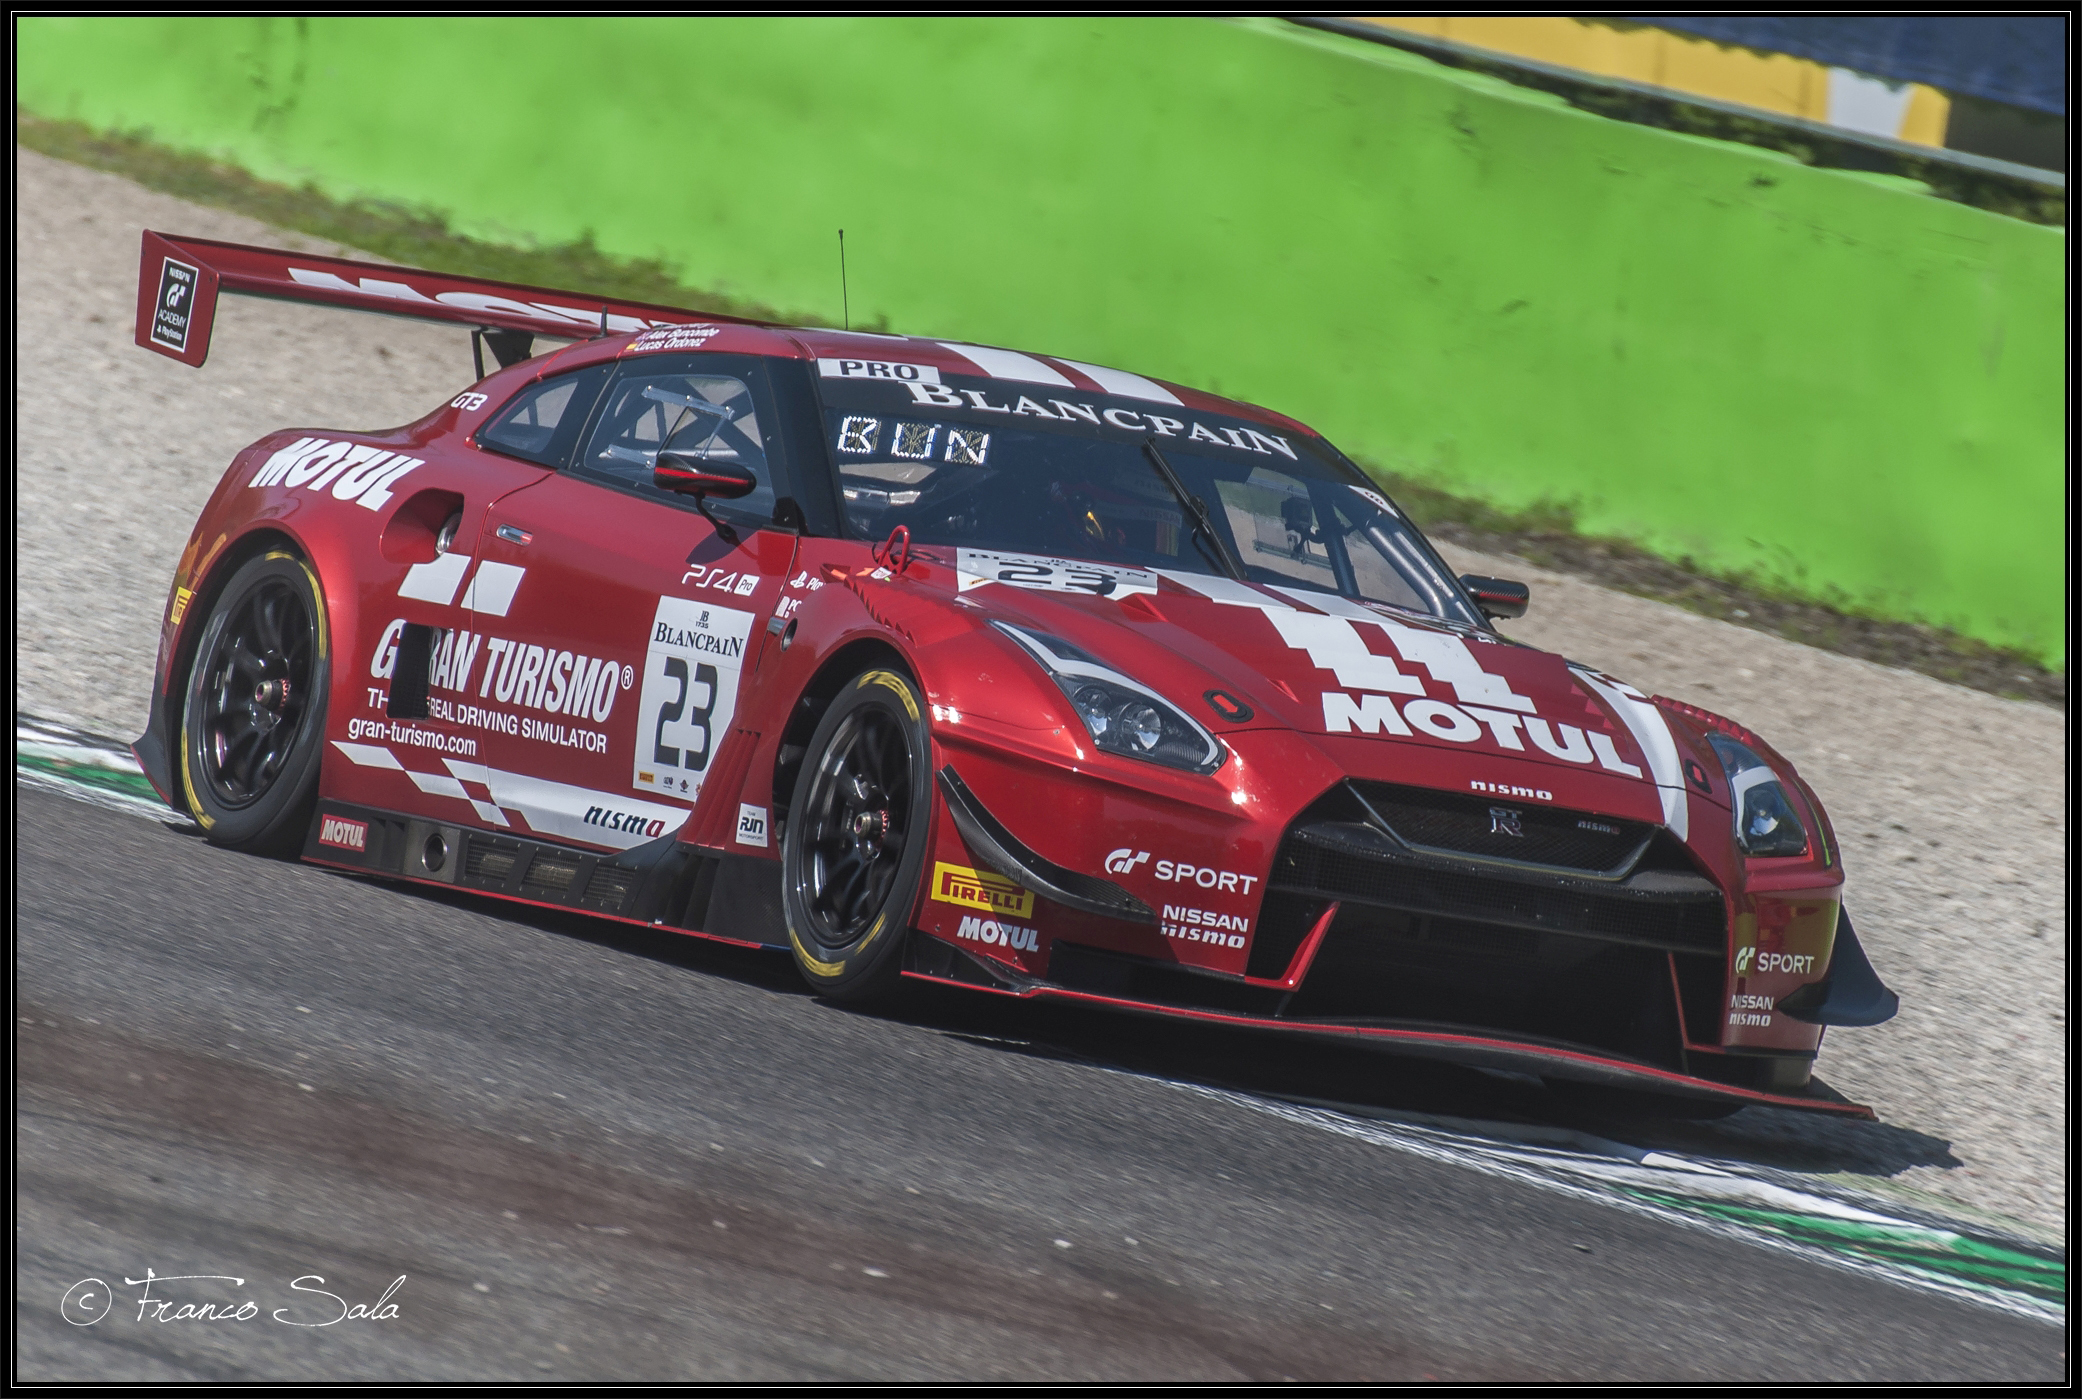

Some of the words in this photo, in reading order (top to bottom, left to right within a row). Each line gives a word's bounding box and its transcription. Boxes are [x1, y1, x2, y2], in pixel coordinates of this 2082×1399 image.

[158, 309, 186, 328] ACADEMY
[162, 325, 183, 341] PlayStation
[633, 339, 664, 352] Lucas
[840, 360, 920, 380] PRO
[450, 391, 488, 412] GT3
[898, 380, 1298, 461] BLANCPAIN
[248, 437, 425, 512] MOTUL
[998, 562, 1117, 596] 23
[653, 622, 744, 658] BLANCPAIN
[457, 703, 518, 736] DRIVING
[521, 718, 608, 754] SIMULATOR
[653, 656, 718, 773] 23
[348, 717, 477, 757] gran-turismo.com
[1322, 691, 1643, 779] MOTUL
[1471, 780, 1553, 801] nismo
[320, 819, 365, 849] MOTUL
[583, 805, 666, 838] nismo
[941, 871, 1026, 911] PIRELLI
[1154, 860, 1258, 895] SPORT
[956, 915, 1039, 952] MOTUL
[1162, 904, 1249, 933] NISSAN
[1757, 952, 1815, 974] SPORT
[1731, 995, 1774, 1011] NISSAN
[1729, 1013, 1771, 1027] nismo
